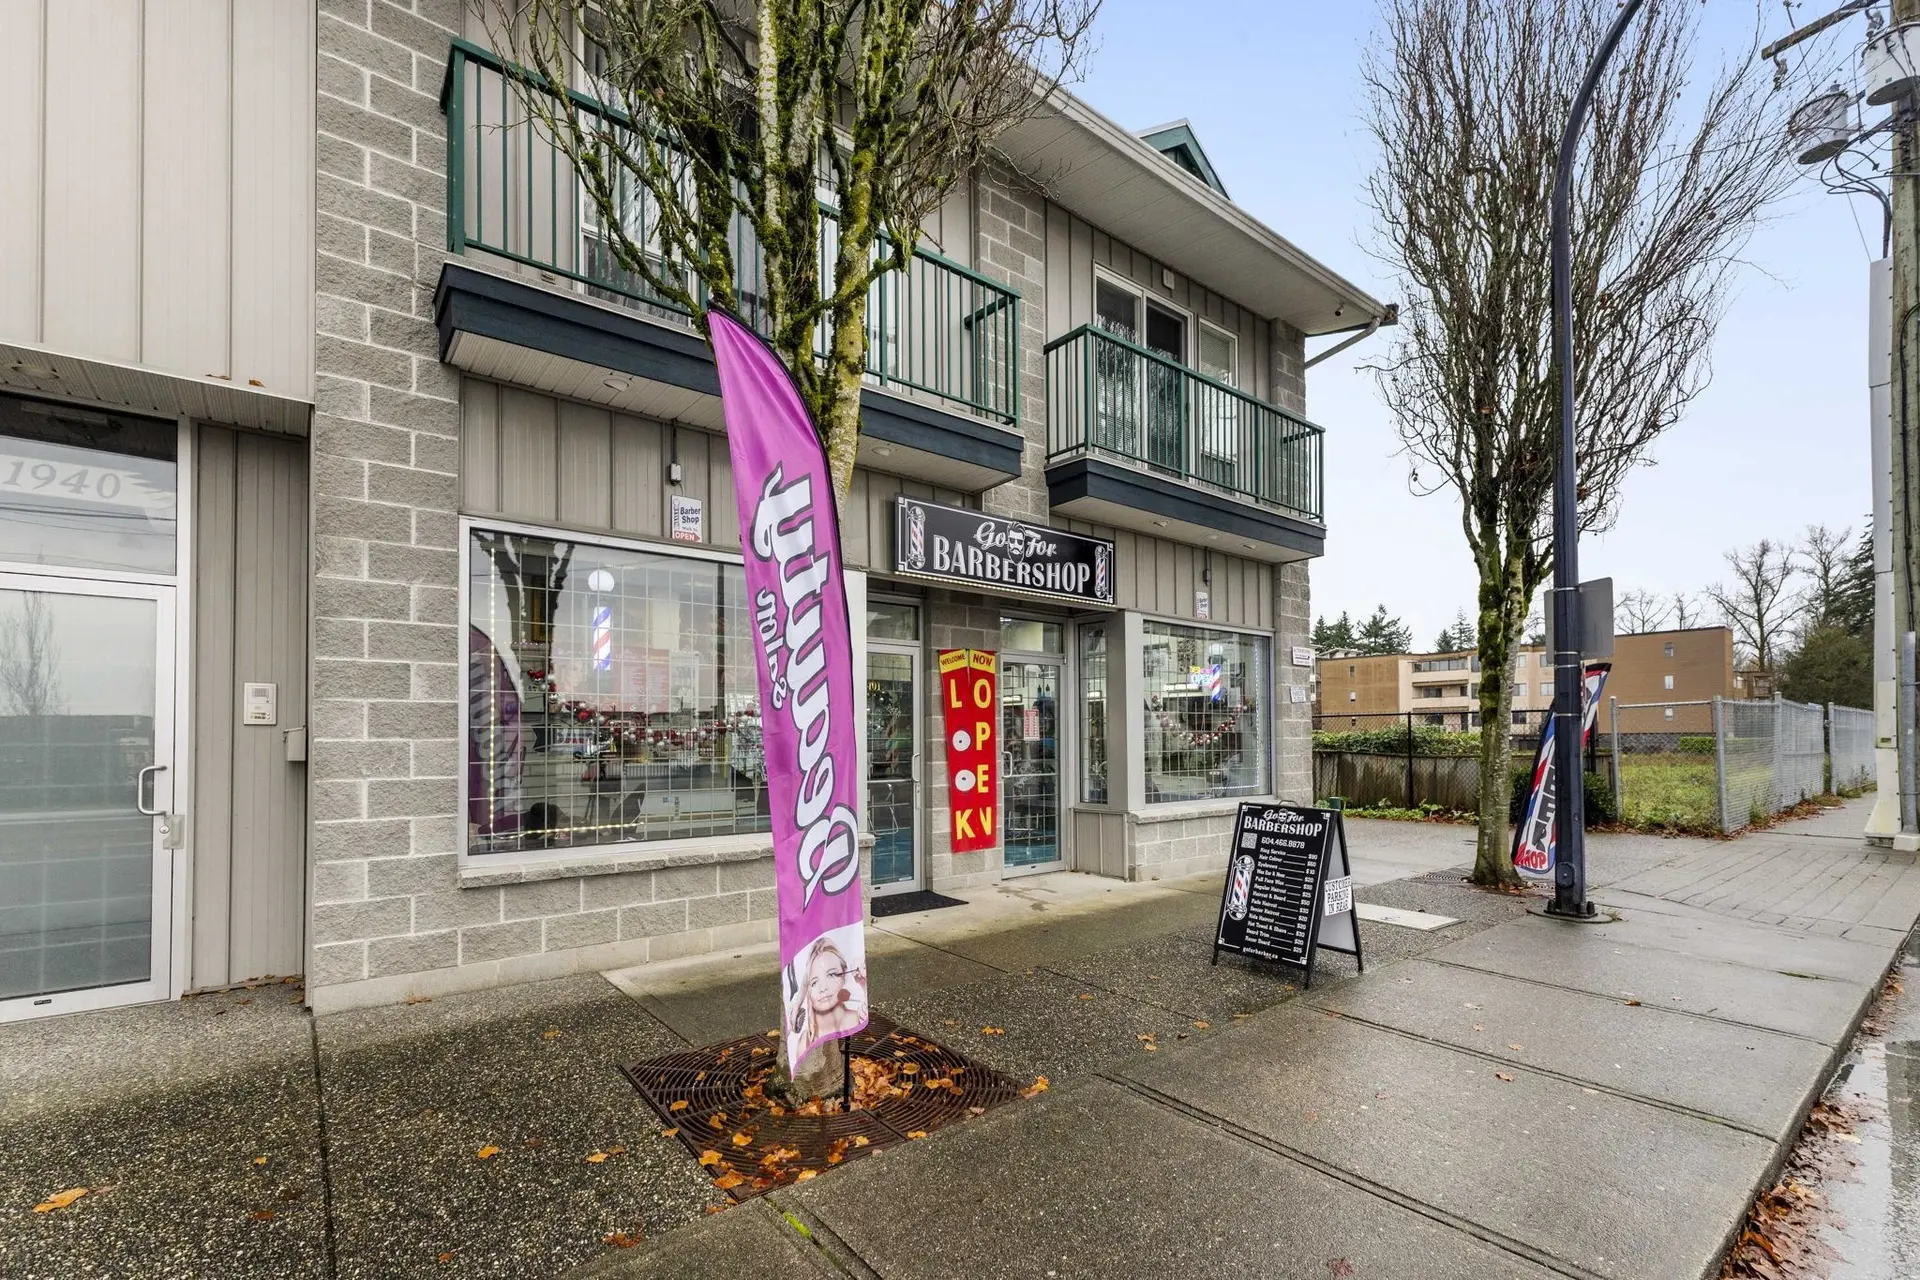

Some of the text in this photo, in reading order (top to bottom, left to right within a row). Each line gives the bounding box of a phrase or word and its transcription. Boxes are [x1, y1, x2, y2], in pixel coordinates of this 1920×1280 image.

[2, 461, 121, 499] 1940
[680, 506, 700, 515] Barber
[682, 516, 700, 524] Shop
[675, 531, 695, 541] OPEN
[973, 522, 1057, 557] Go For
[934, 534, 1090, 594] BARBERSHOP
[941, 653, 966, 666] WELCOME
[973, 654, 992, 666] NOW
[974, 679, 992, 836] OPEN
[1263, 810, 1304, 822] Go For
[1244, 816, 1322, 837] BARBERSHOP
[1328, 889, 1349, 903] PARKING
[1328, 904, 1334, 914] IN
